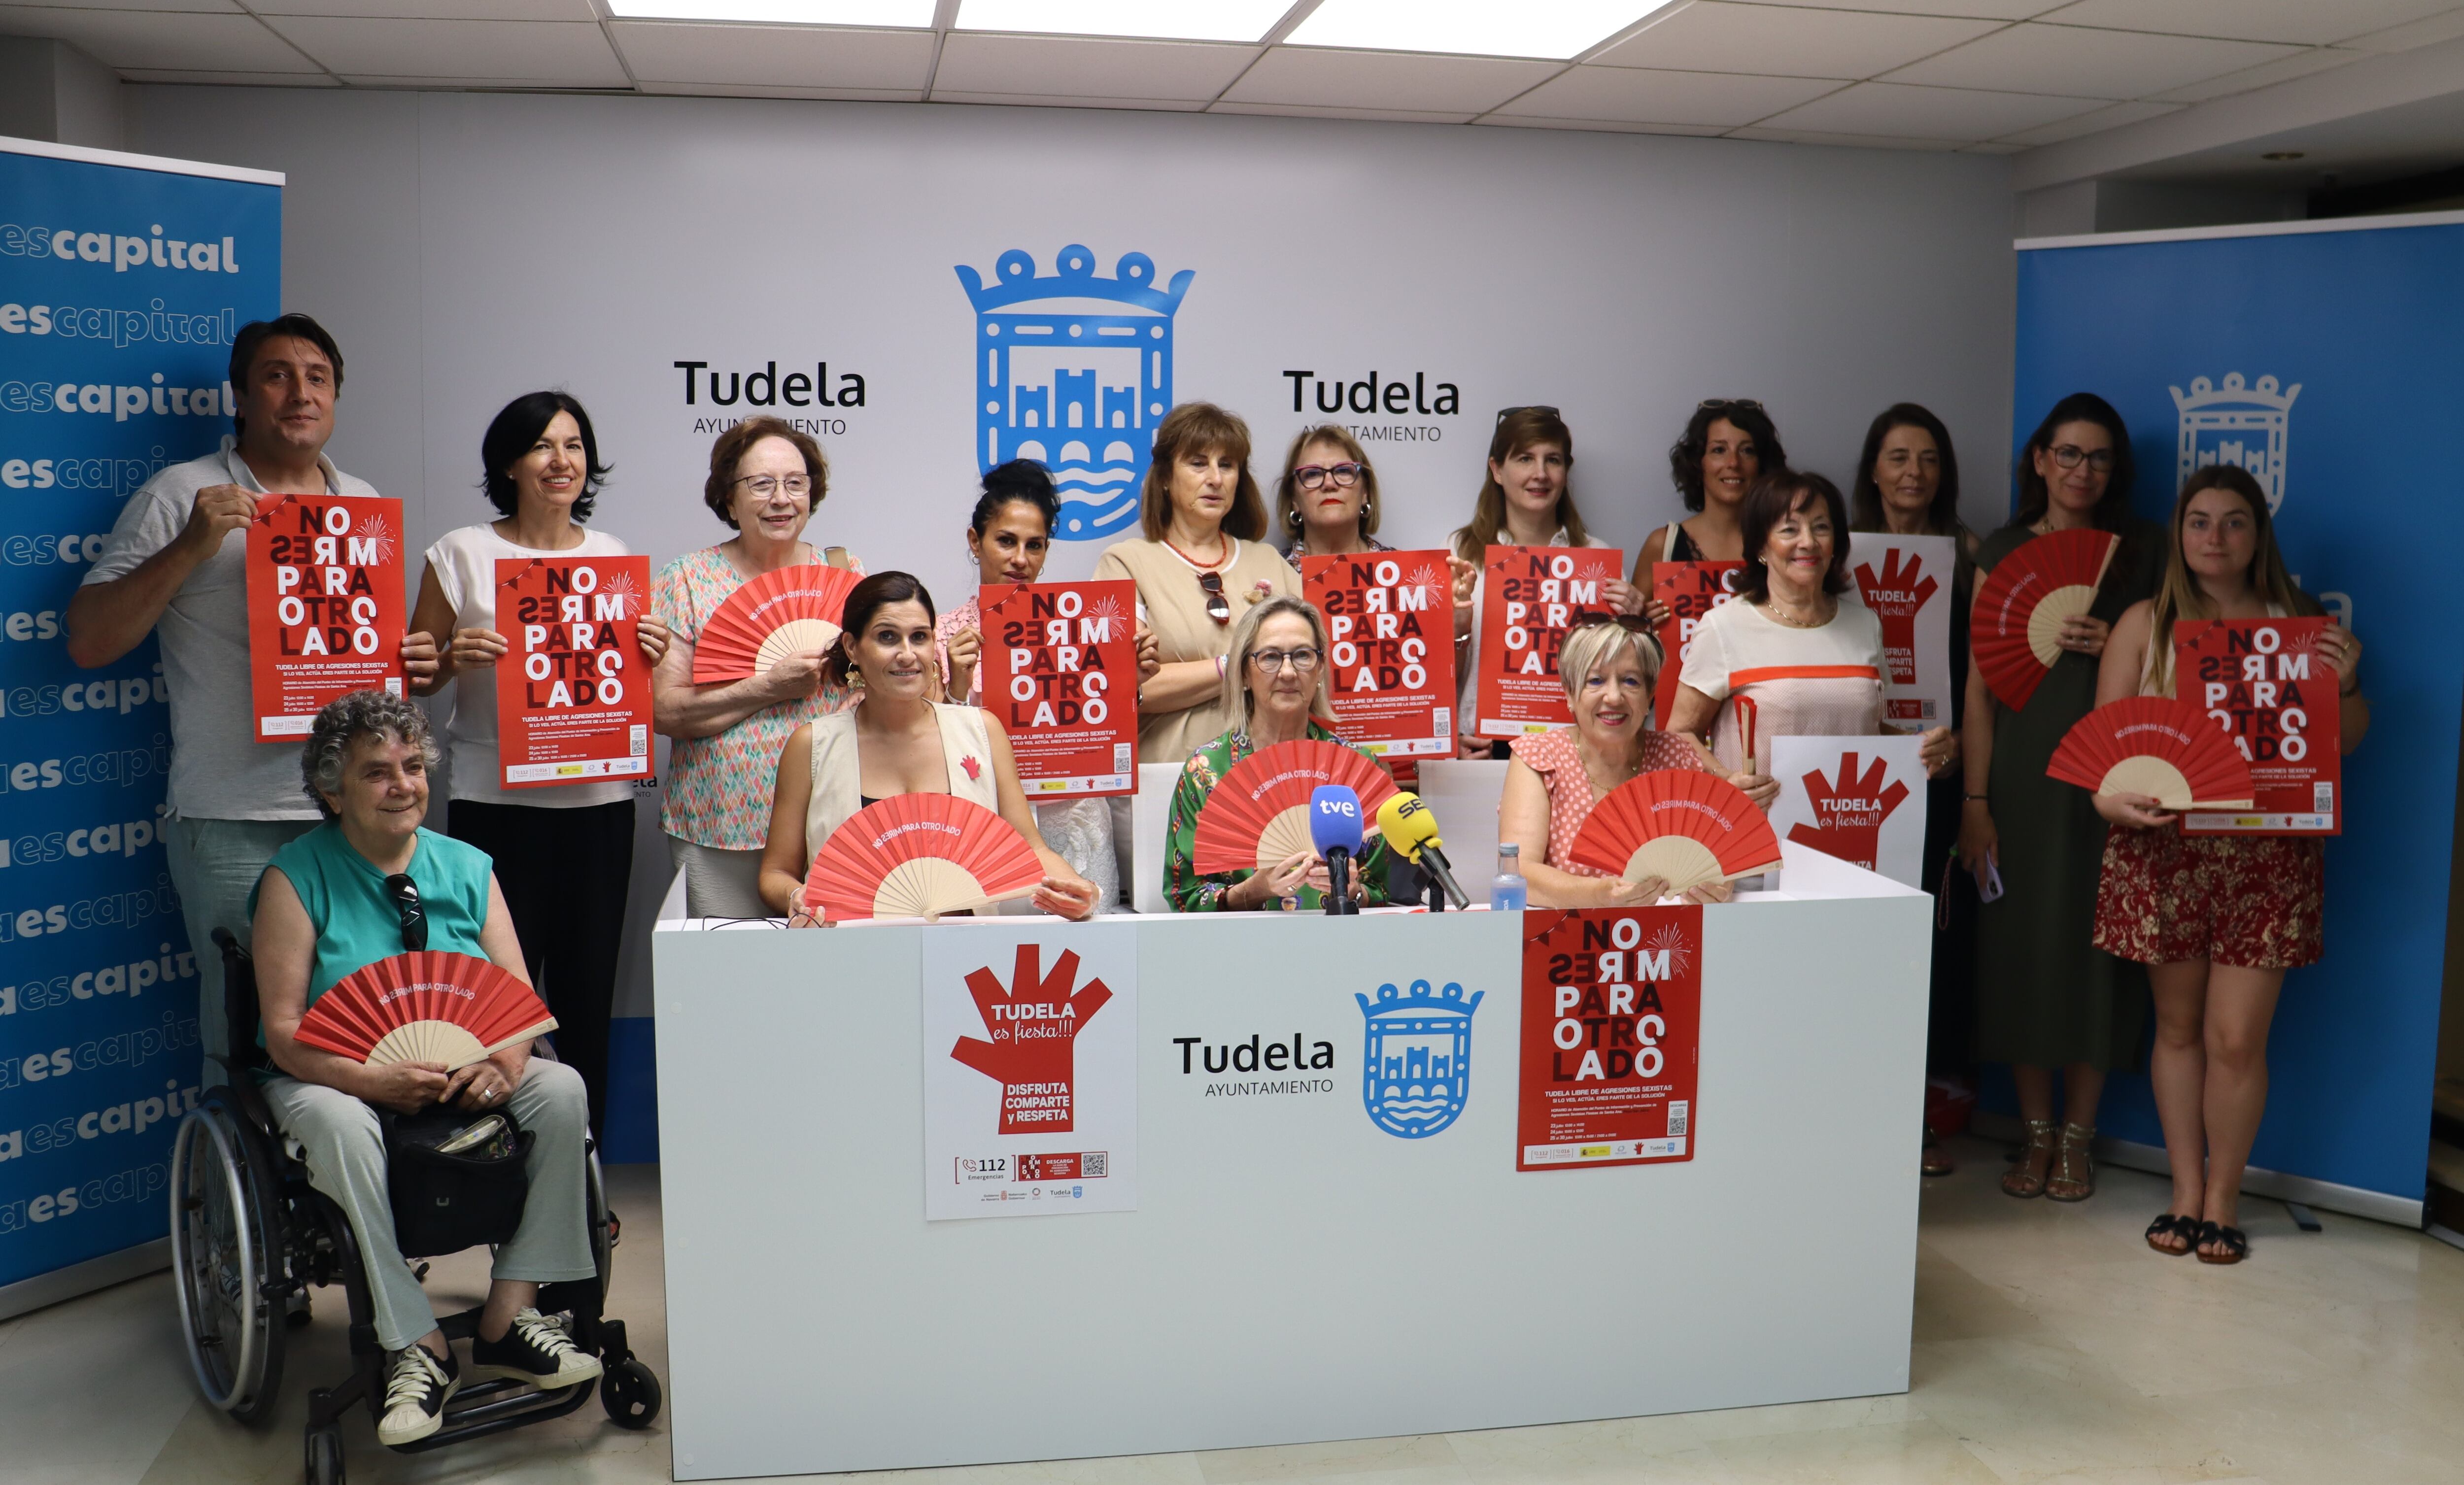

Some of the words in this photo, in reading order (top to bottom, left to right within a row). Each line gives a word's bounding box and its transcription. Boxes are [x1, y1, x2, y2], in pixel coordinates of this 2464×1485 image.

[0, 224, 239, 273] escapital
[0, 372, 237, 422] escapital
[674, 361, 865, 407] Tudela
[1283, 371, 1459, 415] Tudela
[300, 506, 350, 536] NO
[277, 566, 373, 595] PARA
[547, 566, 597, 595] NO
[1351, 560, 1400, 588] NO
[1529, 555, 1574, 579] NO
[771, 593, 787, 604] PARA
[1032, 591, 1083, 619] NO
[1868, 590, 1916, 603] TUDELA
[278, 596, 378, 626] OTRO
[1881, 603, 1914, 619] fiesta!!!
[280, 626, 379, 656] LADO
[525, 623, 620, 652] PARA
[1332, 613, 1423, 641] PARA
[1505, 625, 1567, 650] OTR
[2228, 627, 2280, 654] NO
[525, 650, 623, 680] OTRO
[1011, 645, 1105, 674] PARA
[1332, 638, 1426, 667] OTRO
[1504, 650, 1559, 675] LAD
[1884, 647, 1912, 656] SFRUTA
[1886, 657, 1913, 666] MPARTE
[1334, 664, 1426, 693] LADO
[1891, 667, 1913, 675] SPETA
[526, 677, 624, 709] LADO
[1010, 671, 1108, 701] OTRO
[2205, 681, 2304, 709] PARA
[1011, 698, 1108, 727] LADO
[2234, 734, 2307, 762] ADO
[1251, 790, 1261, 801] NO
[1276, 772, 1293, 783] PARA
[1294, 770, 1311, 778] OTRO
[1312, 770, 1329, 780] LADO
[1320, 800, 1355, 817] tve
[1650, 803, 1661, 813] NO
[1683, 800, 1700, 810] PARA
[1701, 805, 1718, 819] OTRO
[1716, 814, 1733, 832] LADO
[1820, 798, 1882, 811] TUDELA
[872, 838, 883, 849] NO
[902, 822, 921, 833] PARA
[921, 822, 941, 831] OTRO
[942, 824, 960, 836] LADO
[1820, 817, 1832, 826] es
[1836, 812, 1880, 831] fiesta!!!
[1583, 918, 1640, 950] NO
[378, 995, 390, 1006] NO
[413, 982, 433, 992] PARA
[434, 982, 455, 993] OTRO
[455, 986, 475, 1000] LADO
[1555, 983, 1663, 1017] PARA
[991, 1003, 1076, 1020] TUDELA
[993, 1029, 1009, 1040] es
[1014, 1019, 1073, 1045] fiesta!!!
[1553, 1014, 1665, 1050] OTRO
[1173, 1033, 1334, 1074] Tudela
[1552, 1046, 1663, 1081] LADO
[1007, 1082, 1068, 1095] DISFRUTA
[1205, 1079, 1333, 1097] AYUNTAMIENTO
[1005, 1096, 1070, 1109] COMPARTE
[1007, 1113, 1015, 1125] y
[1017, 1110, 1068, 1122] RESPETA
[979, 1159, 1005, 1171] 112
